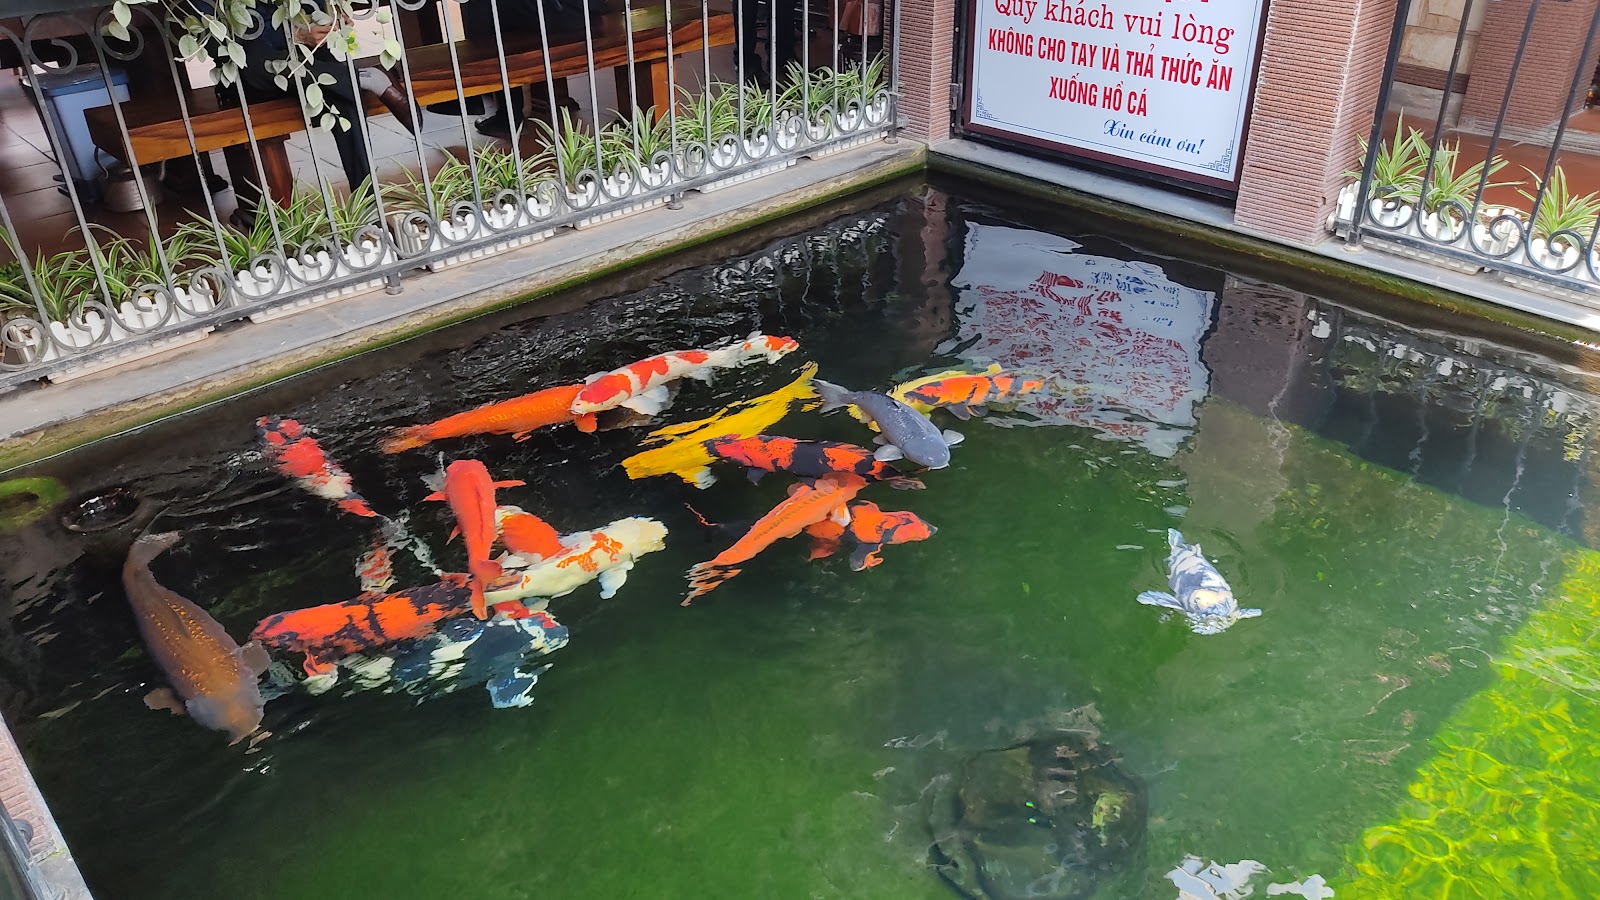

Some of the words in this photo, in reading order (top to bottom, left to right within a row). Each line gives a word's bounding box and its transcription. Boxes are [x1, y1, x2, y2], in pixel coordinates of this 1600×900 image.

[1043, 0, 1114, 30] khách
[1124, 11, 1162, 37] vui
[1171, 13, 1235, 54] lòng
[988, 27, 1033, 57] KHÔNG
[1038, 36, 1065, 62] CHO
[1071, 41, 1097, 68] TAY
[1102, 43, 1120, 72] VÀ
[1126, 43, 1154, 78] THẢ
[1160, 52, 1201, 86] THỨC
[1206, 58, 1233, 92] ĂN
[1049, 72, 1098, 107] XUỐNG
[1102, 81, 1124, 111] HỒ
[1127, 88, 1147, 117] CÁ
[1103, 119, 1134, 140] Xin
[1176, 138, 1205, 154] ơn!
